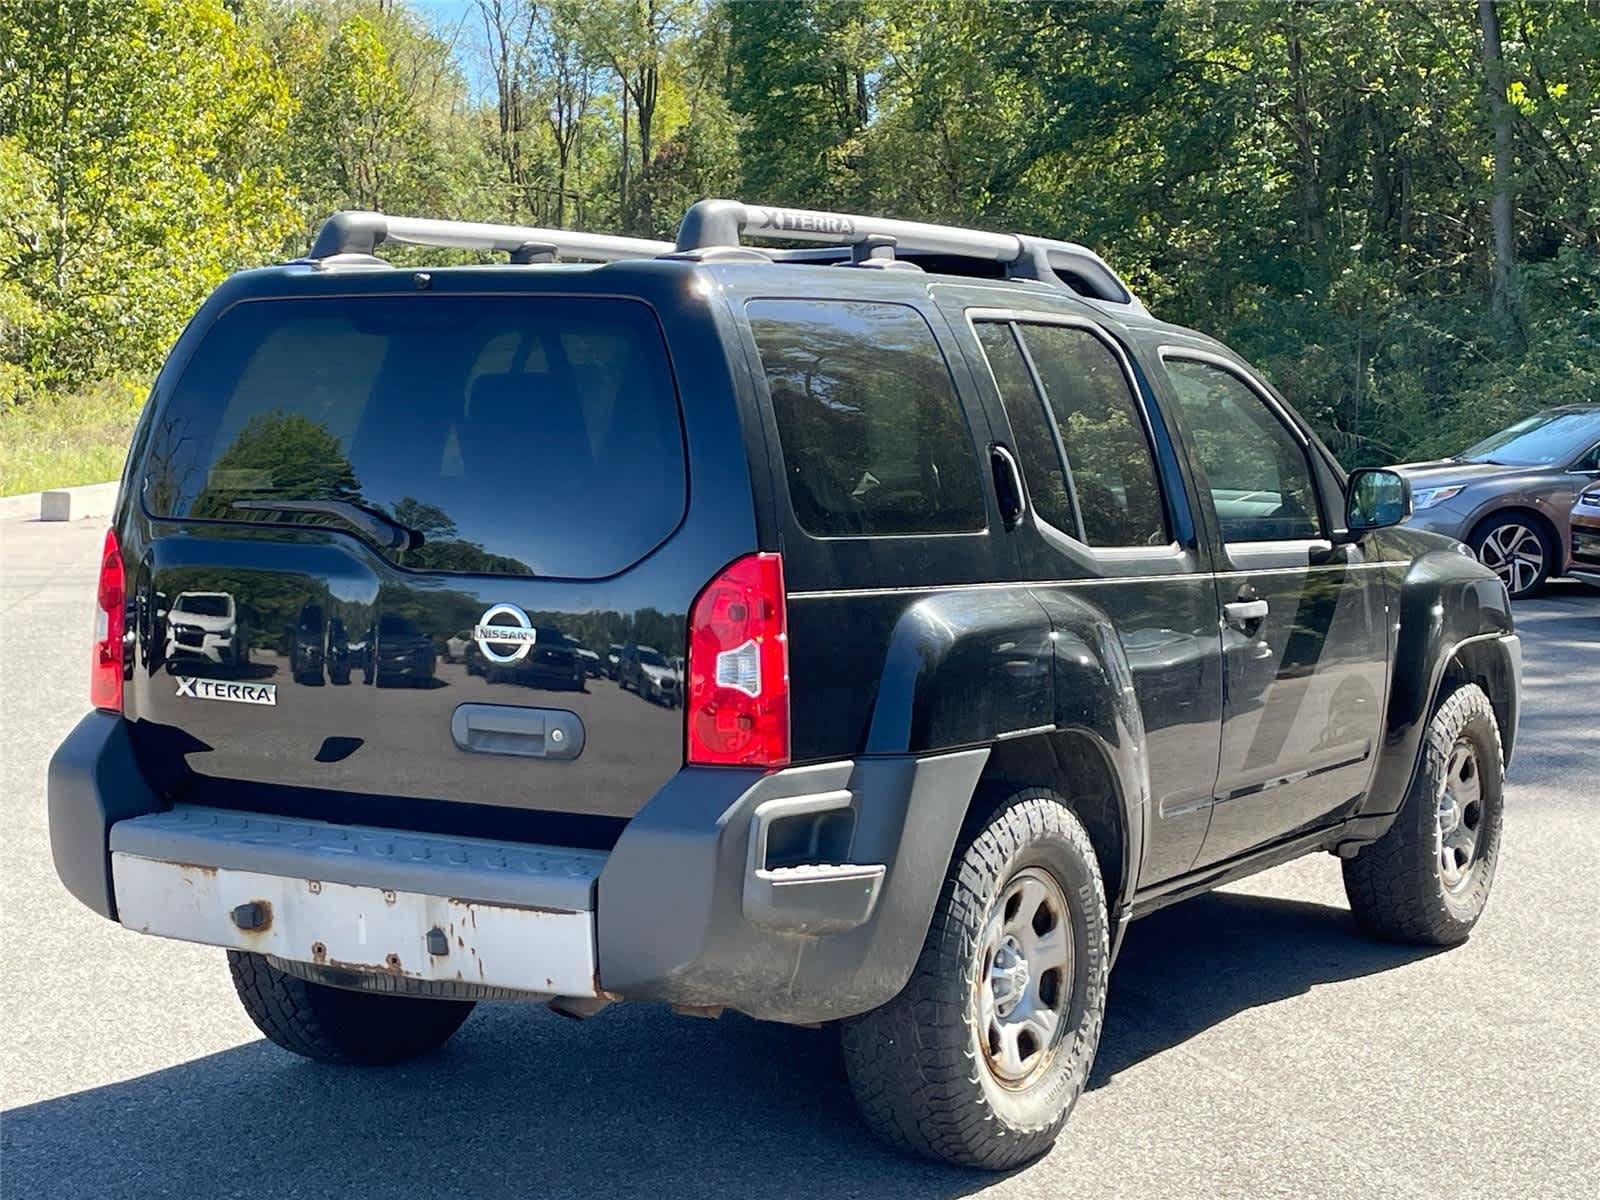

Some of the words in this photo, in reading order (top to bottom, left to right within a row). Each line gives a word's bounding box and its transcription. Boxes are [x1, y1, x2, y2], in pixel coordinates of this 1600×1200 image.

[760, 210, 855, 235] XTERRA
[479, 627, 530, 641] NISSAN
[176, 676, 273, 704] XTERRA
